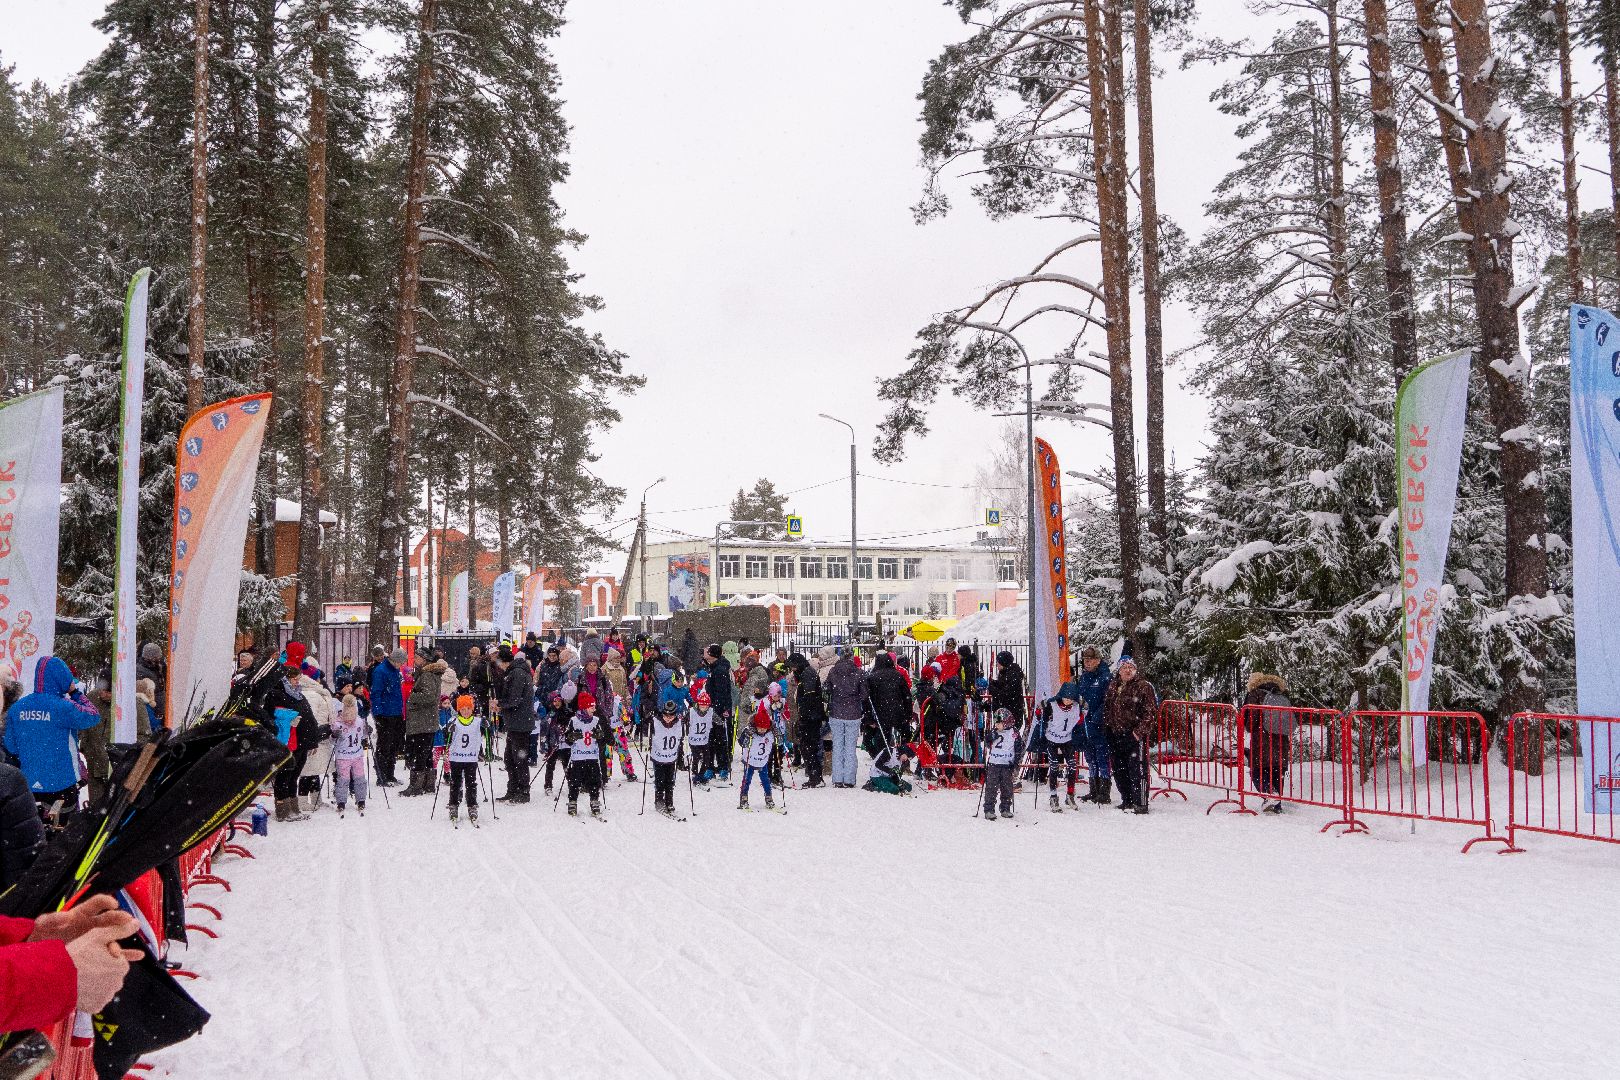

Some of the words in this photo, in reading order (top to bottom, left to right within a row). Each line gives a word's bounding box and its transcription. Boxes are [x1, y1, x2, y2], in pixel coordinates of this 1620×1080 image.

[19, 710, 51, 722] RUSSIA
[694, 722, 707, 735] 12
[1062, 718, 1069, 732] 1
[347, 733, 359, 748] 14
[461, 733, 470, 749] 9
[583, 731, 592, 747] 8
[662, 735, 677, 751] 10
[995, 735, 1004, 749] 2
[757, 742, 766, 756] 3
